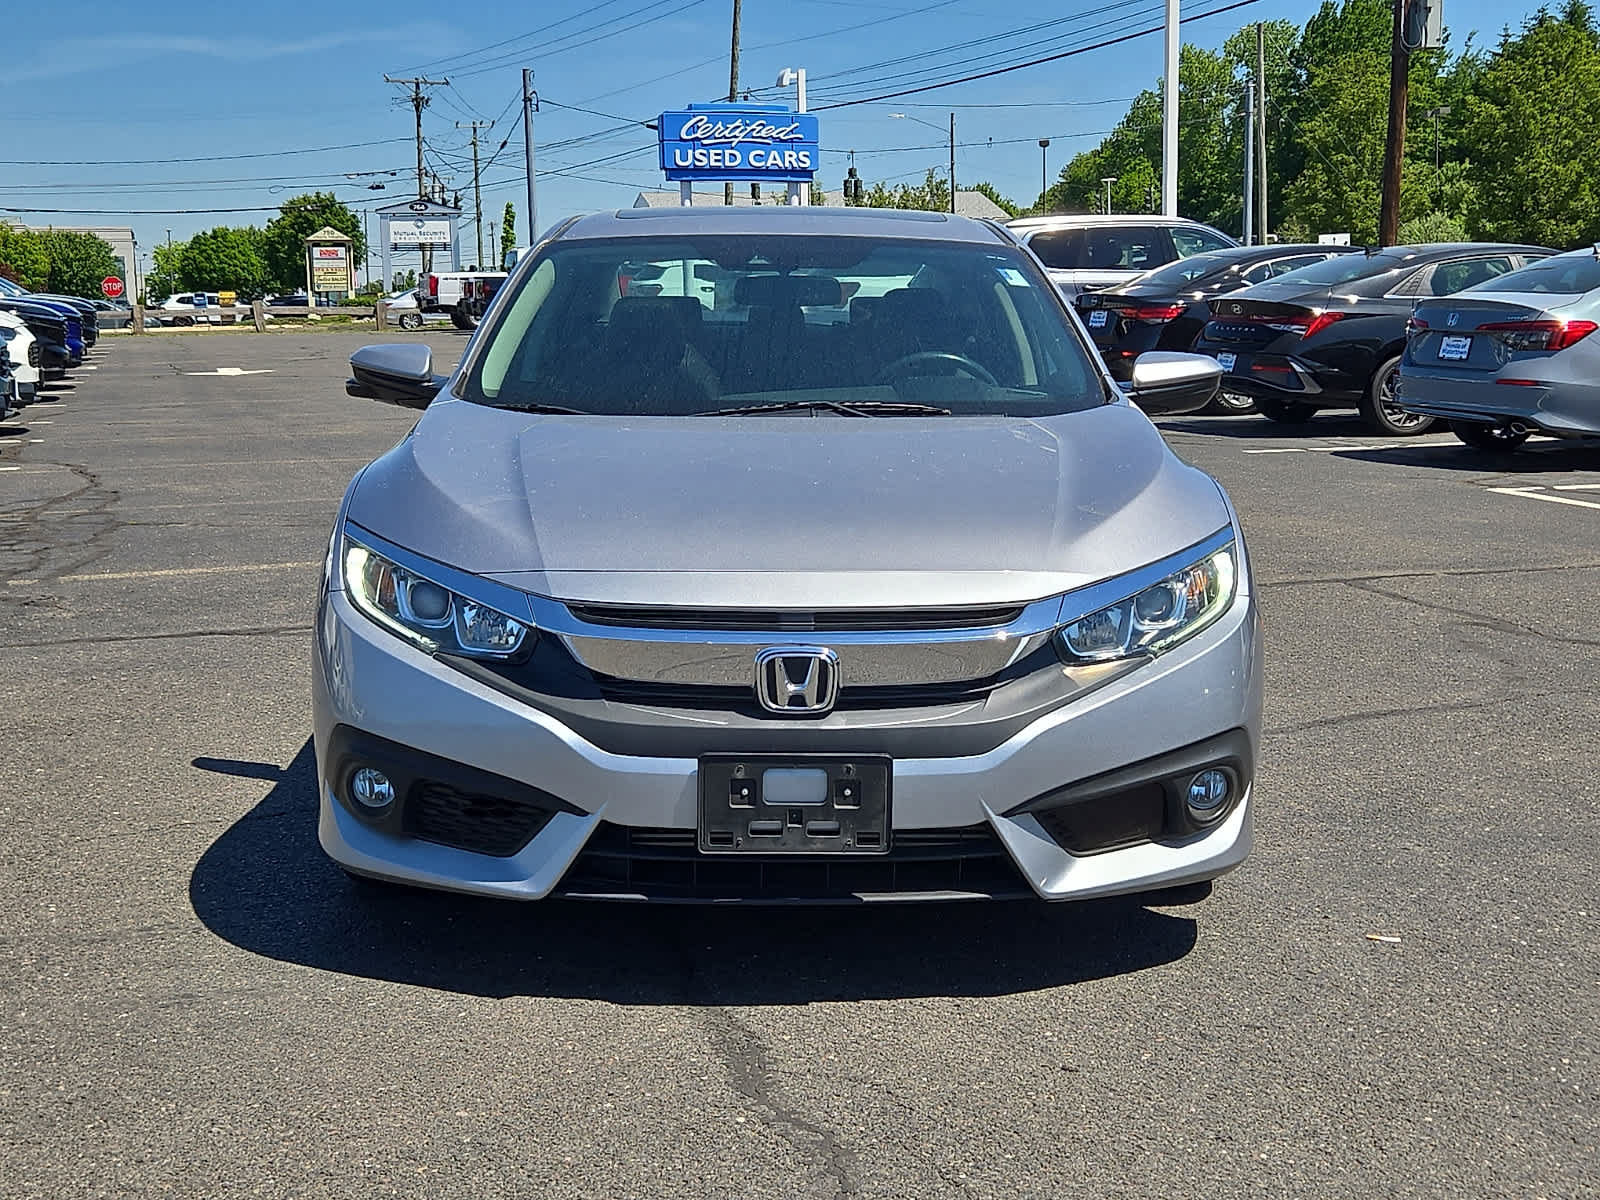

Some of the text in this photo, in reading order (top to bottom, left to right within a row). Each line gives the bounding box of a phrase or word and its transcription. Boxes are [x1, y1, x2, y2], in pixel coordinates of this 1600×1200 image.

[680, 115, 804, 147] Certified
[674, 149, 811, 169] USED CARS
[103, 282, 122, 291] STOP
